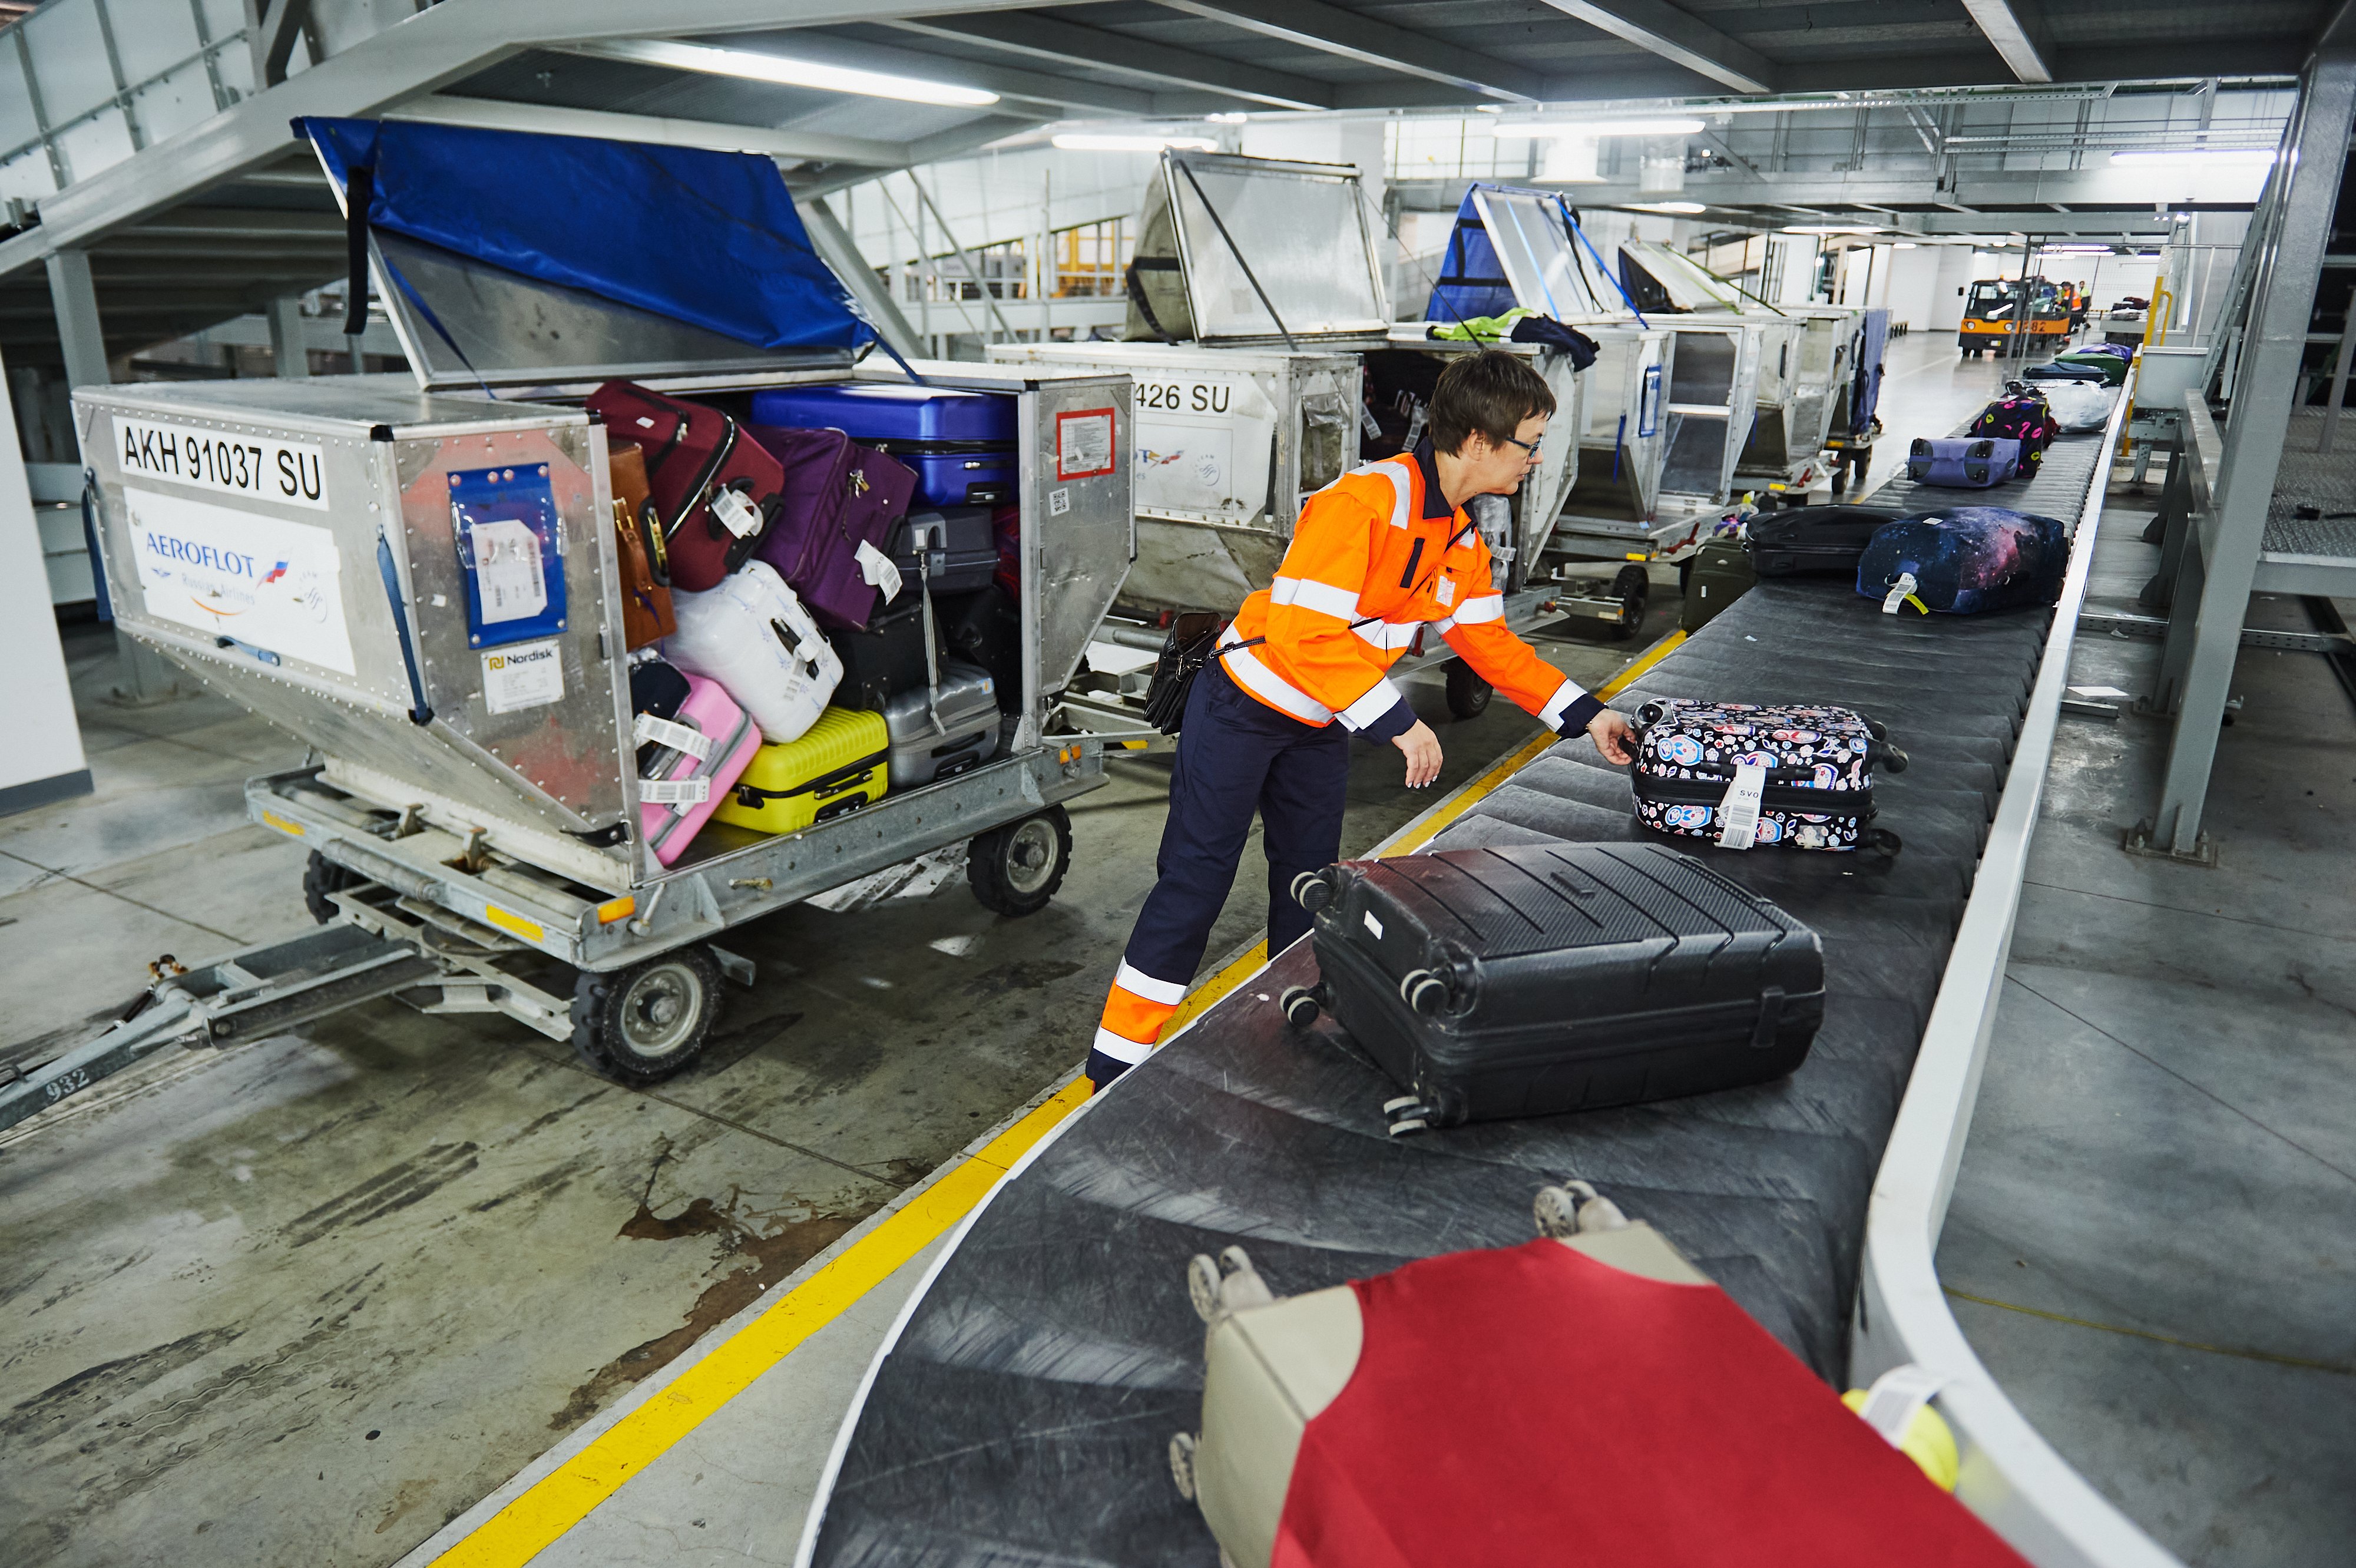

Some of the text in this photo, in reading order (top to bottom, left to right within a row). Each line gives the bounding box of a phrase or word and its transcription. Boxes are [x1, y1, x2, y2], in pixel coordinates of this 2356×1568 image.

[1191, 385, 1230, 413] SU
[125, 426, 321, 500] AKH 91037 SU
[147, 532, 254, 578] AEROFLOT
[221, 583, 255, 606] Airlines
[507, 649, 552, 665] Nordisk
[1740, 790, 1759, 798] SVO
[46, 1069, 90, 1101] 932
